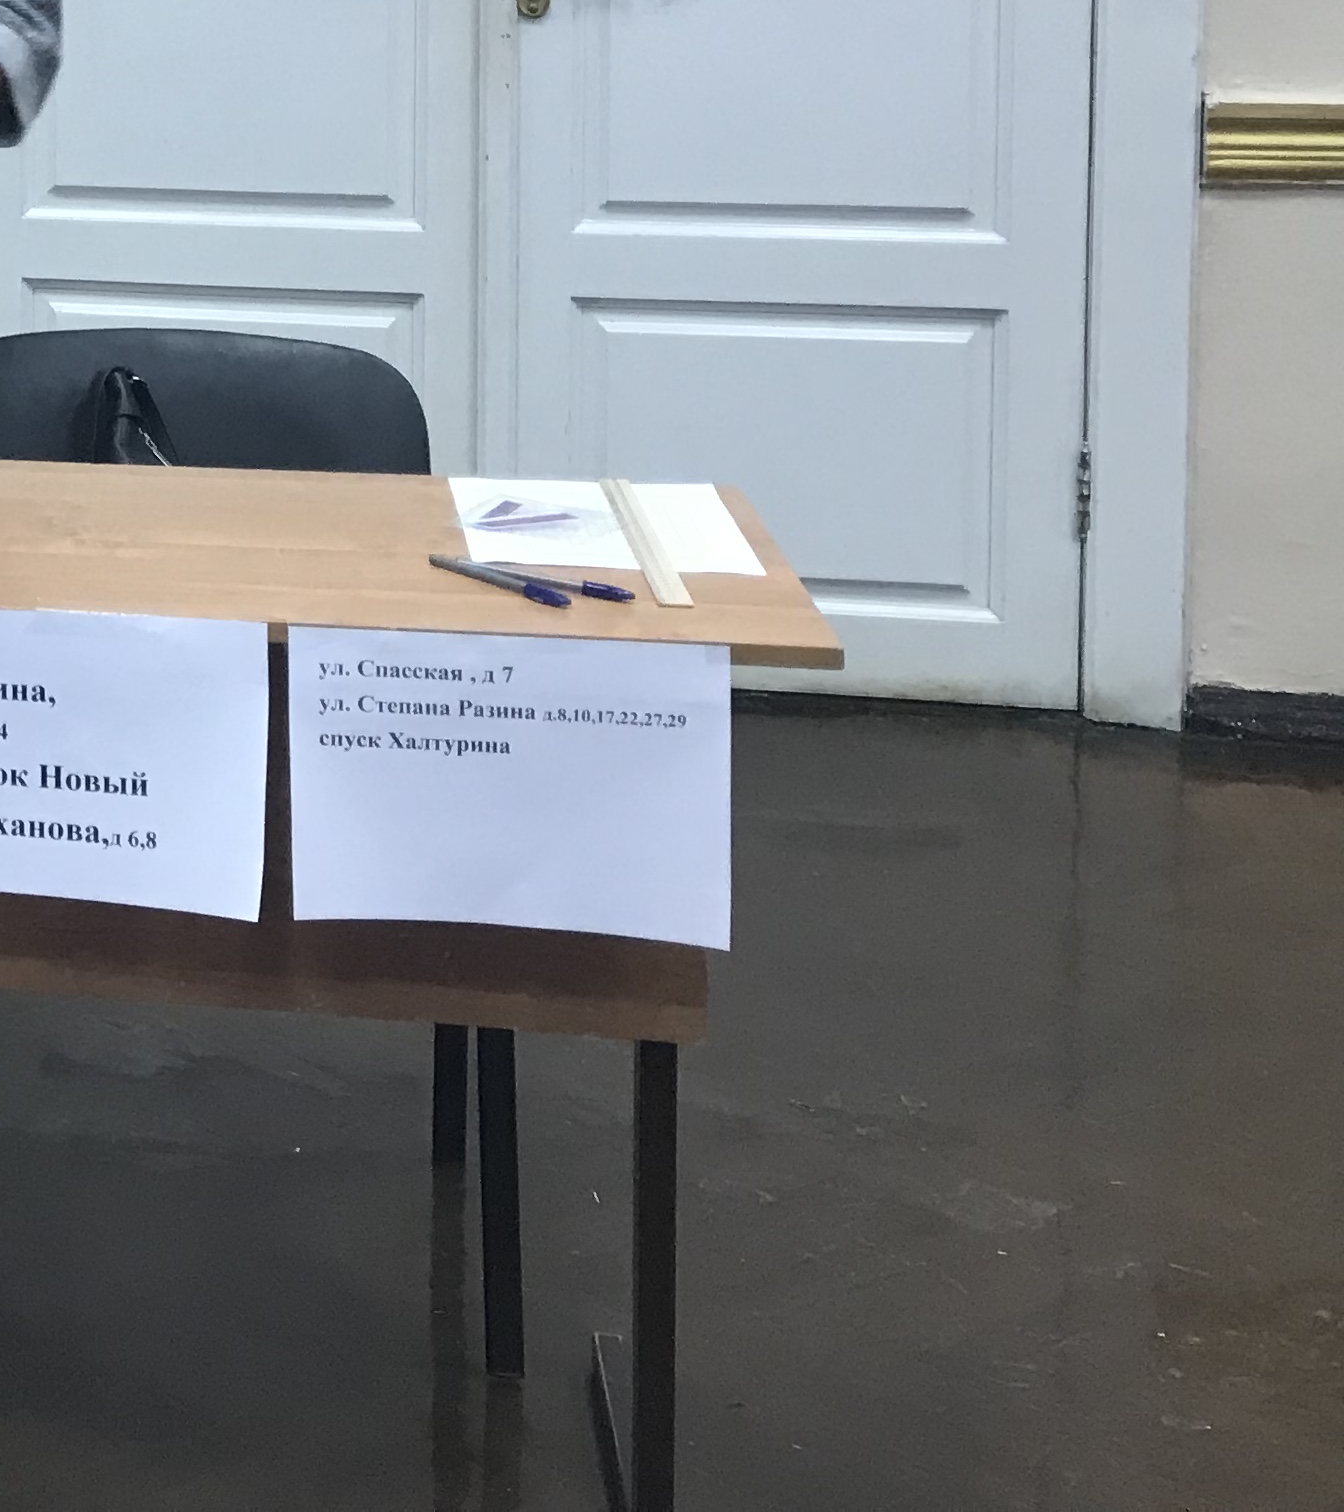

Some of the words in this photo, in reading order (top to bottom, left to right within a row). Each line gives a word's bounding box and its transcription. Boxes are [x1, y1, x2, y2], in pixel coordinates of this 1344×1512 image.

[318, 662, 350, 680] ул.
[357, 659, 463, 682] Спасская
[482, 670, 495, 684] д
[502, 666, 514, 683] 7
[318, 697, 350, 715] ул.
[357, 695, 451, 716] Степана
[458, 699, 536, 720] Разина
[542, 708, 687, 729] д.8,10,17,22,27,29
[319, 733, 381, 752] спуск
[388, 731, 511, 757] Халтурина
[39, 764, 149, 797] Новый
[127, 830, 157, 850] 6,8
